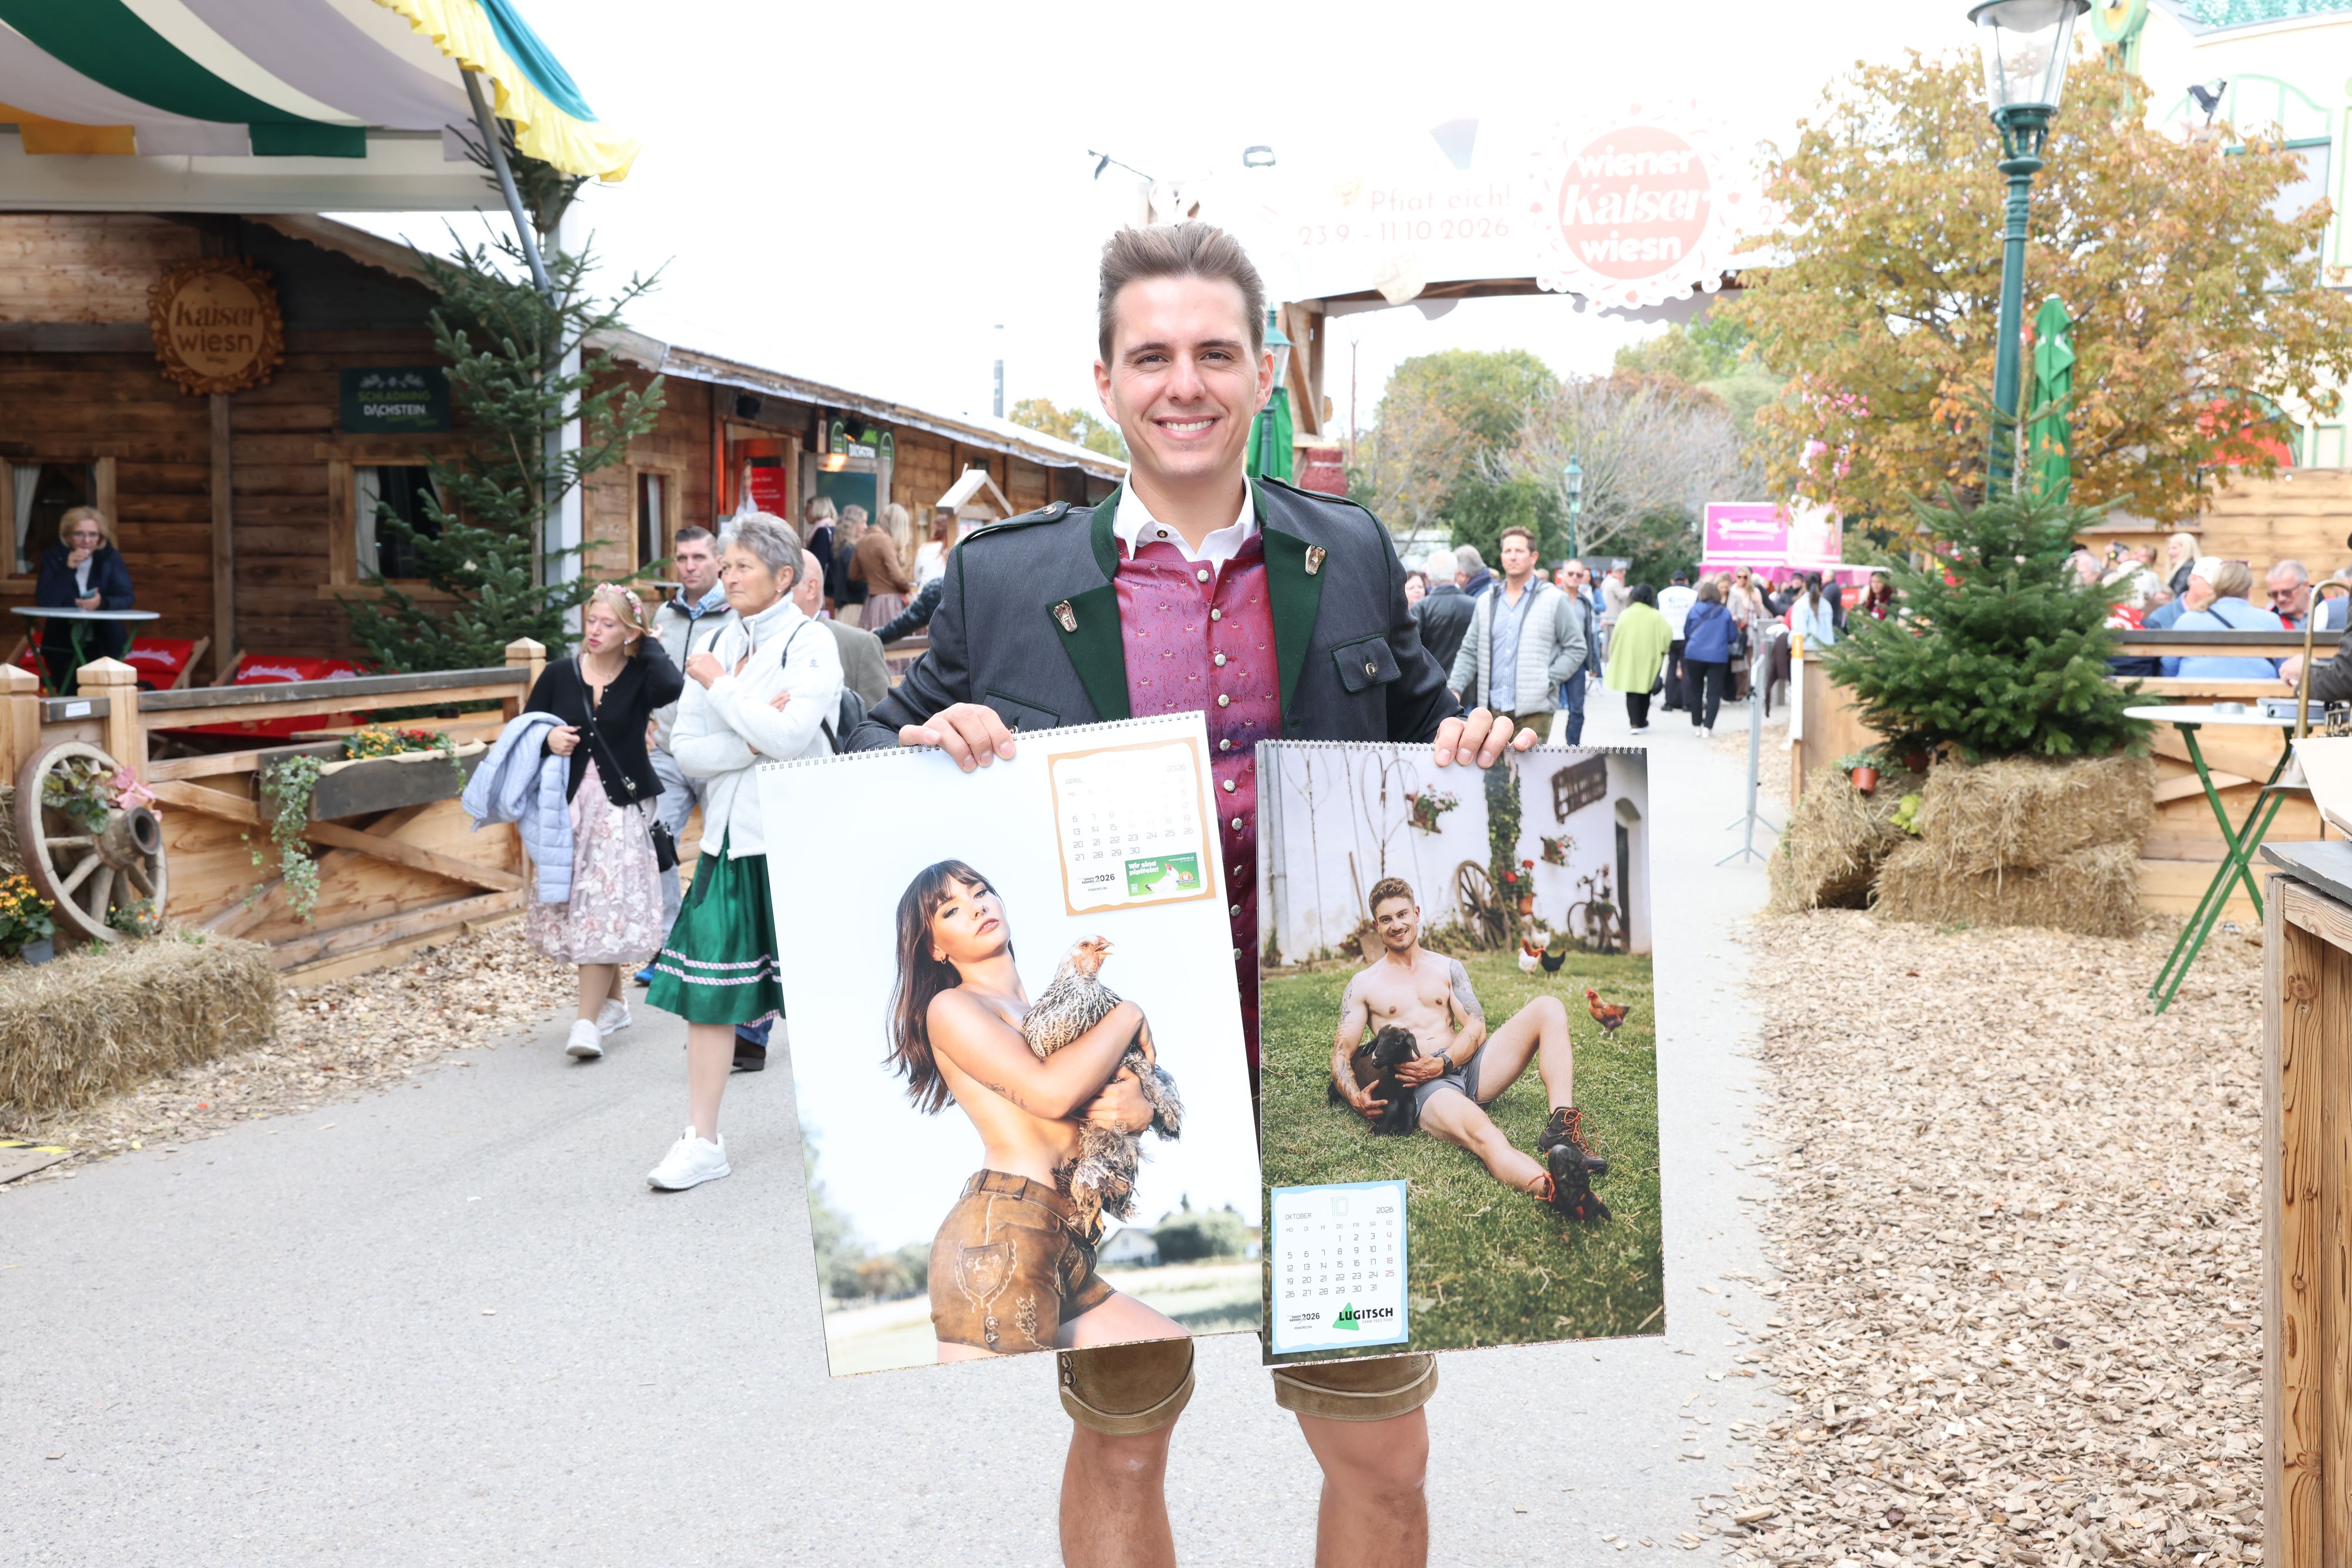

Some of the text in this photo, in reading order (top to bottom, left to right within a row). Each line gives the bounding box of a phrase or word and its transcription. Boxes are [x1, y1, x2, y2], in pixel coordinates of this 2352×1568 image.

[1576, 145, 1696, 179] wiener
[1371, 183, 1509, 212] Pfiat eich!
[1562, 184, 1711, 226] Kaiser
[1580, 230, 1681, 263] wiesn
[176, 300, 255, 326] Kaiser
[176, 328, 253, 353] wiesn
[363, 404, 426, 418] DACHSTEIN
[1167, 764, 1186, 773] 2026
[1095, 874, 1115, 882] 2026
[1330, 1197, 1348, 1216] 10
[1339, 1308, 1393, 1321] LUGITSCH
